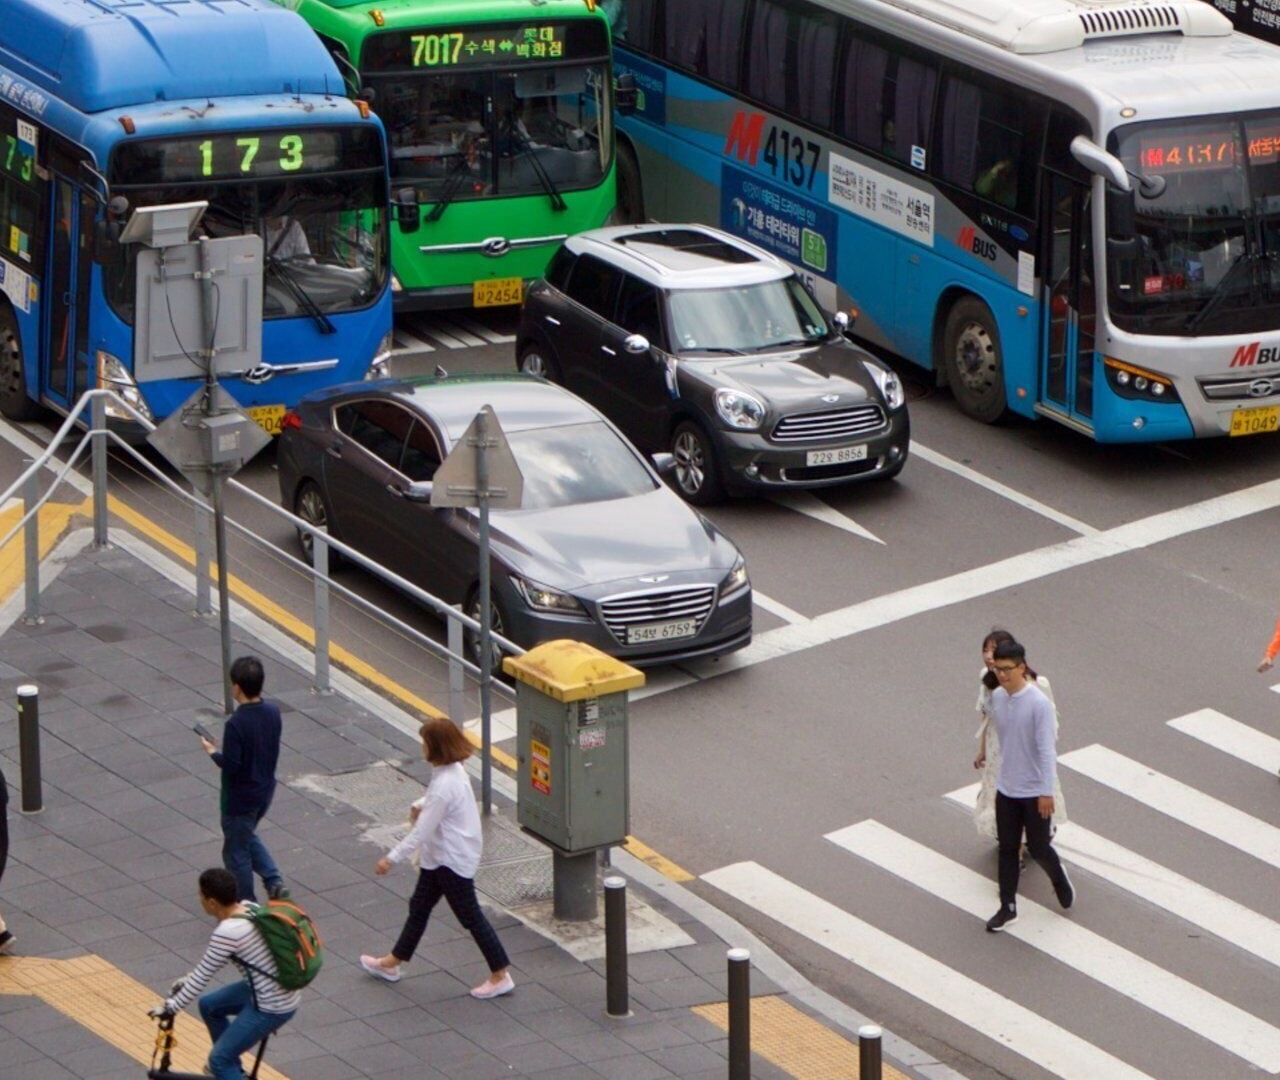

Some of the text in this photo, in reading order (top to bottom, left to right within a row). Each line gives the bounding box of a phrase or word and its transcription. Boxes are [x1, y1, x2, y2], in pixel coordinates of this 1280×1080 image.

[411, 33, 495, 67] 7017 수색
[516, 41, 562, 58] 백화점
[763, 125, 821, 192] 4137
[838, 450, 863, 461] 8856
[662, 623, 690, 637] 6759
